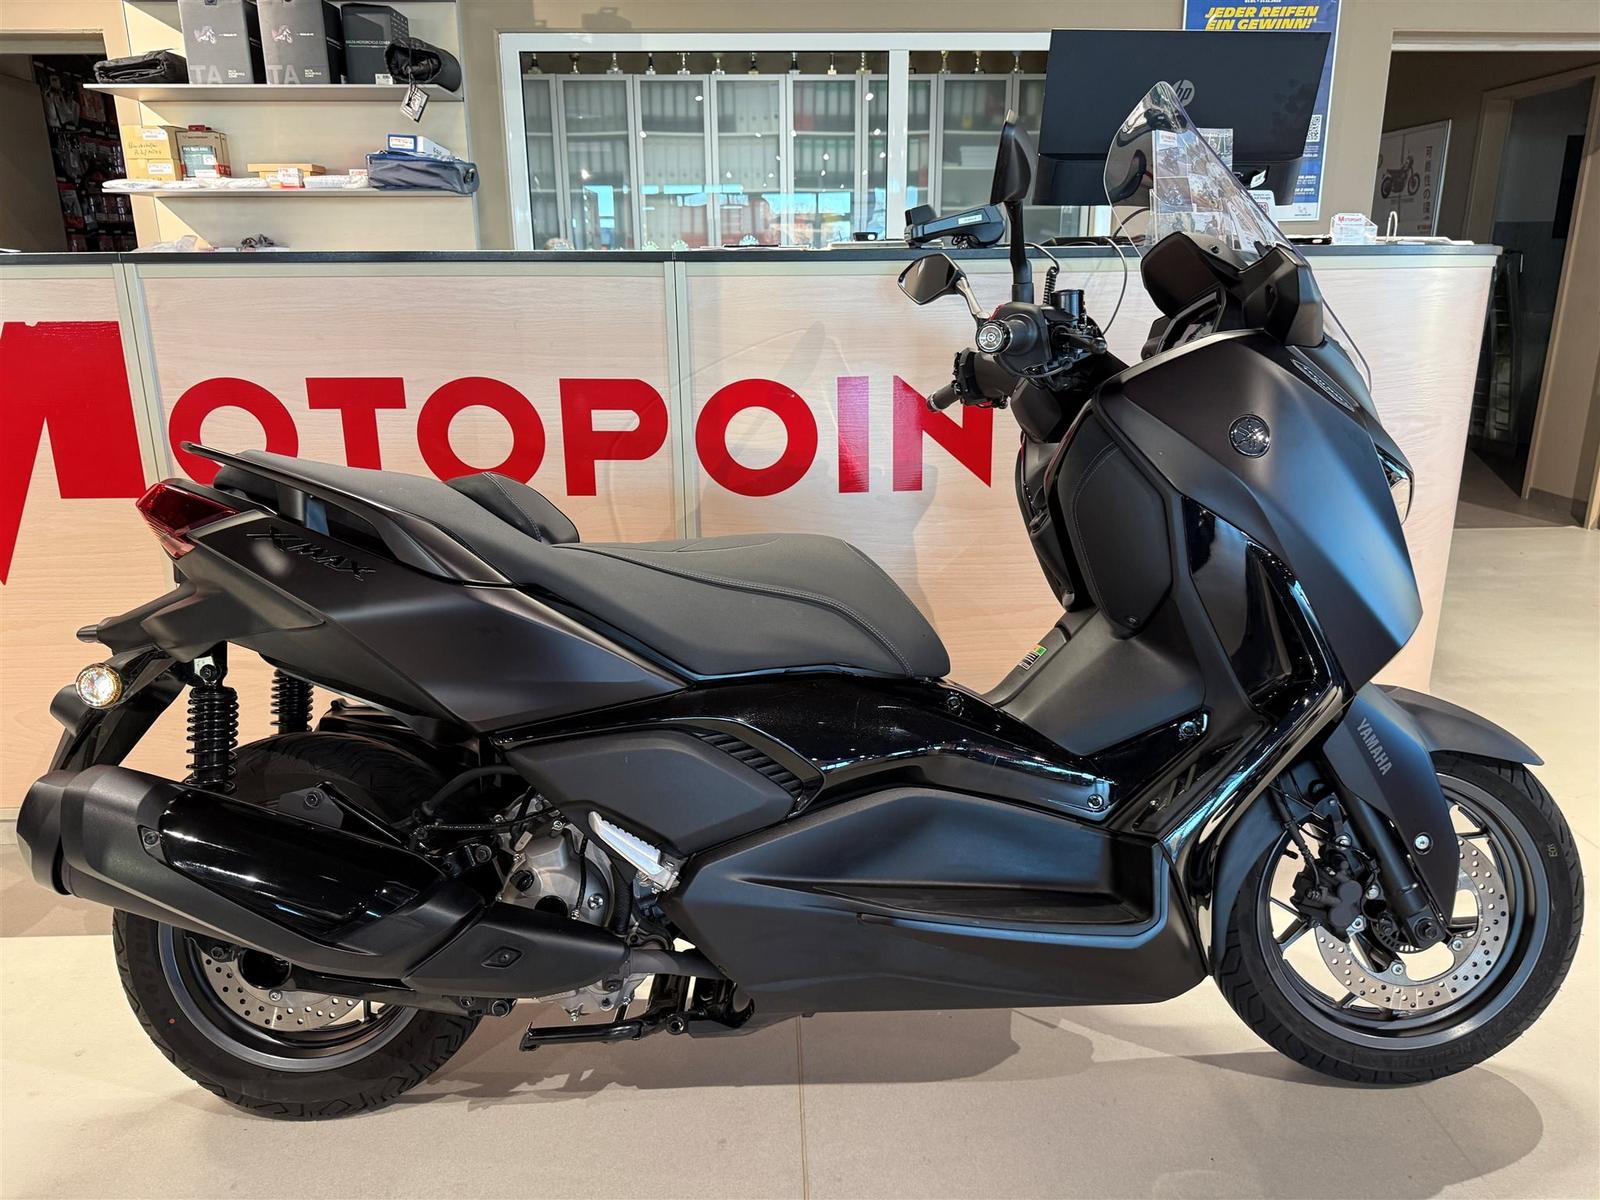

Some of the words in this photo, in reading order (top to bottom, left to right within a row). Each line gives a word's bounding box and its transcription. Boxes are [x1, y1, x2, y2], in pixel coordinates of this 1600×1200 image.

[1205, 7, 1258, 18] JEDER
[1259, 6, 1319, 17] REIFEN
[1206, 19, 1235, 30] EIN
[190, 65, 223, 84] TA
[267, 65, 300, 84] TA
[1175, 80, 1193, 105] hp
[246, 524, 376, 581] XMAX
[1357, 717, 1393, 776] YAMAHA
